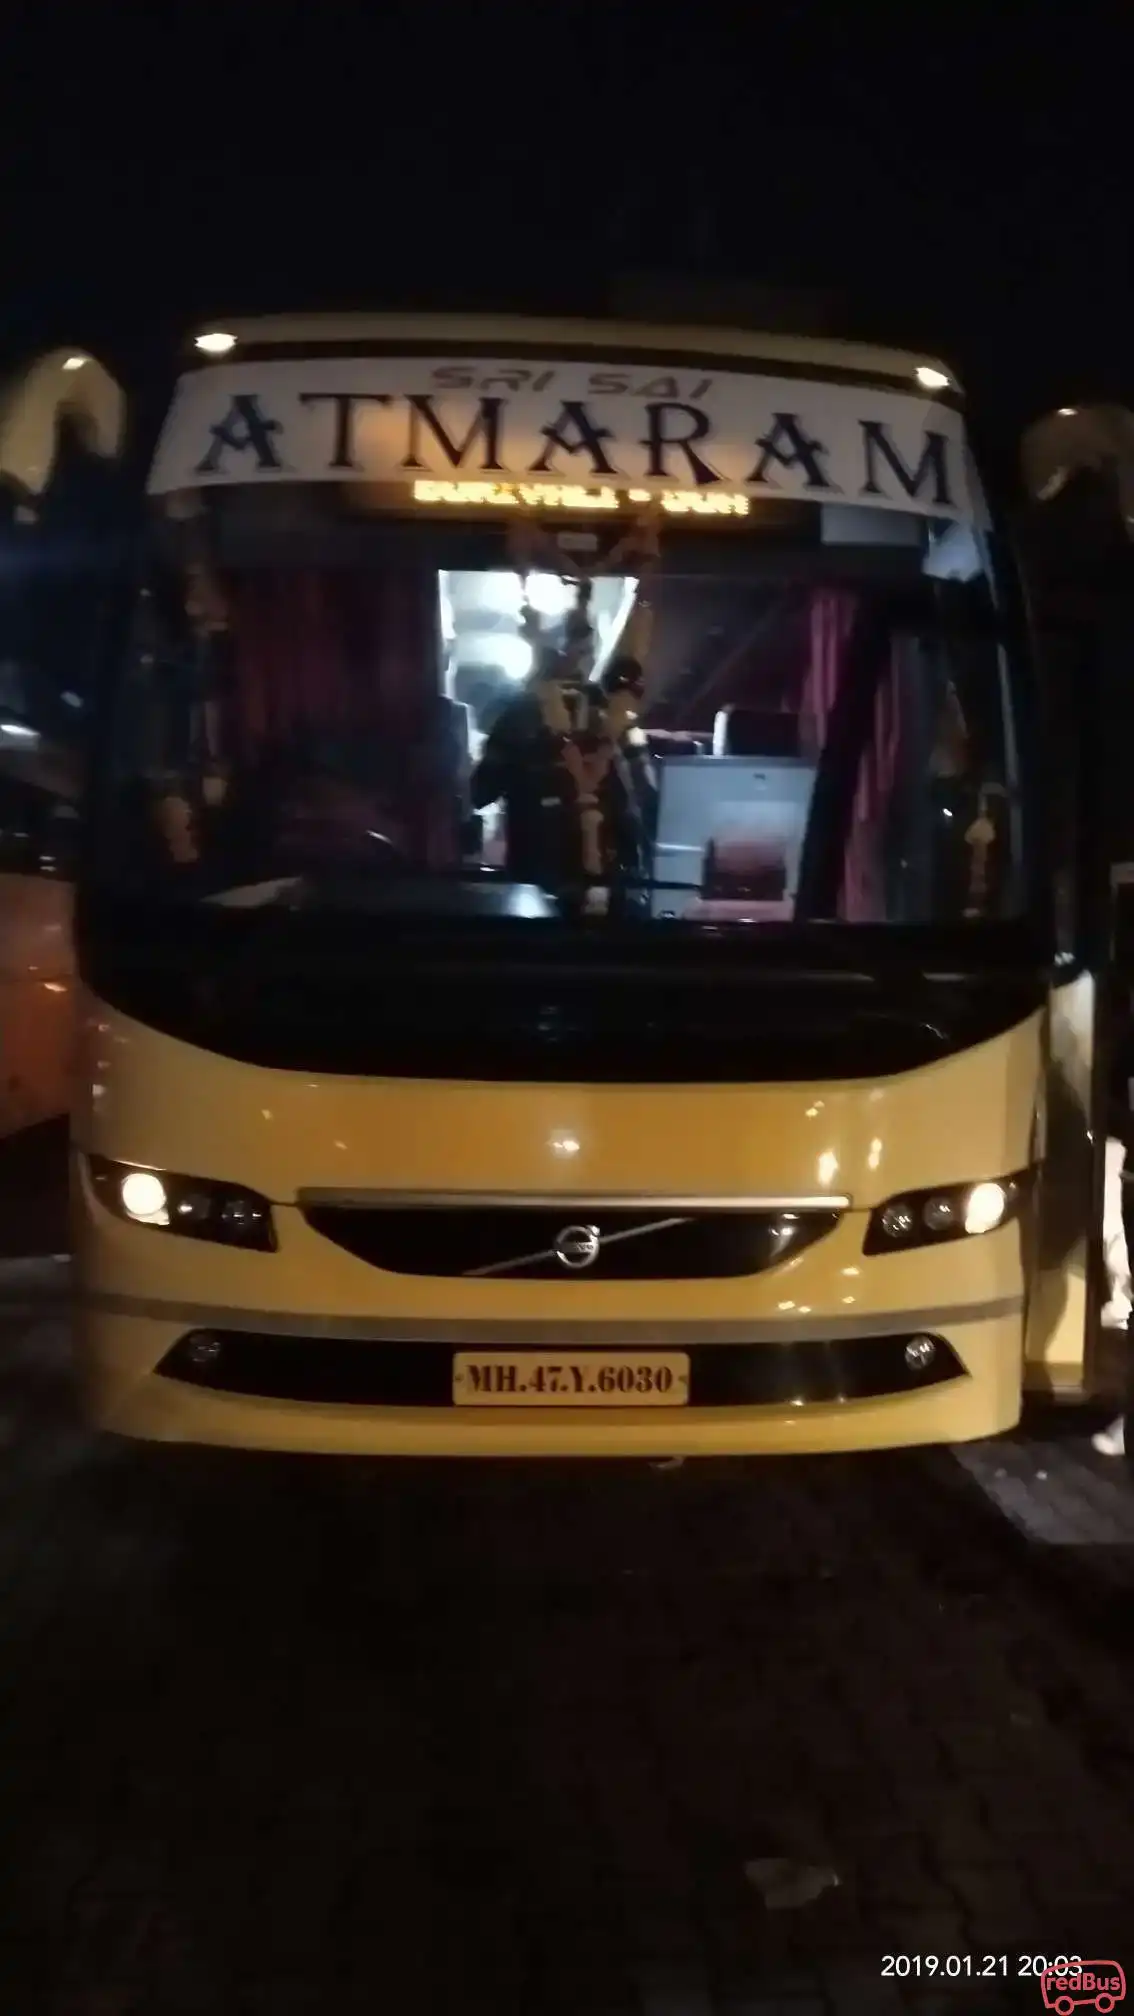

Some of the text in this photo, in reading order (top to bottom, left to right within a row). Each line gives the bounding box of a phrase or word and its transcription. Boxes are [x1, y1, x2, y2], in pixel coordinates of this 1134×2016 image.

[432, 365, 713, 399] SRI SAI
[195, 394, 959, 508] ATMARAM
[466, 1364, 674, 1394] MH.47.Y.6030
